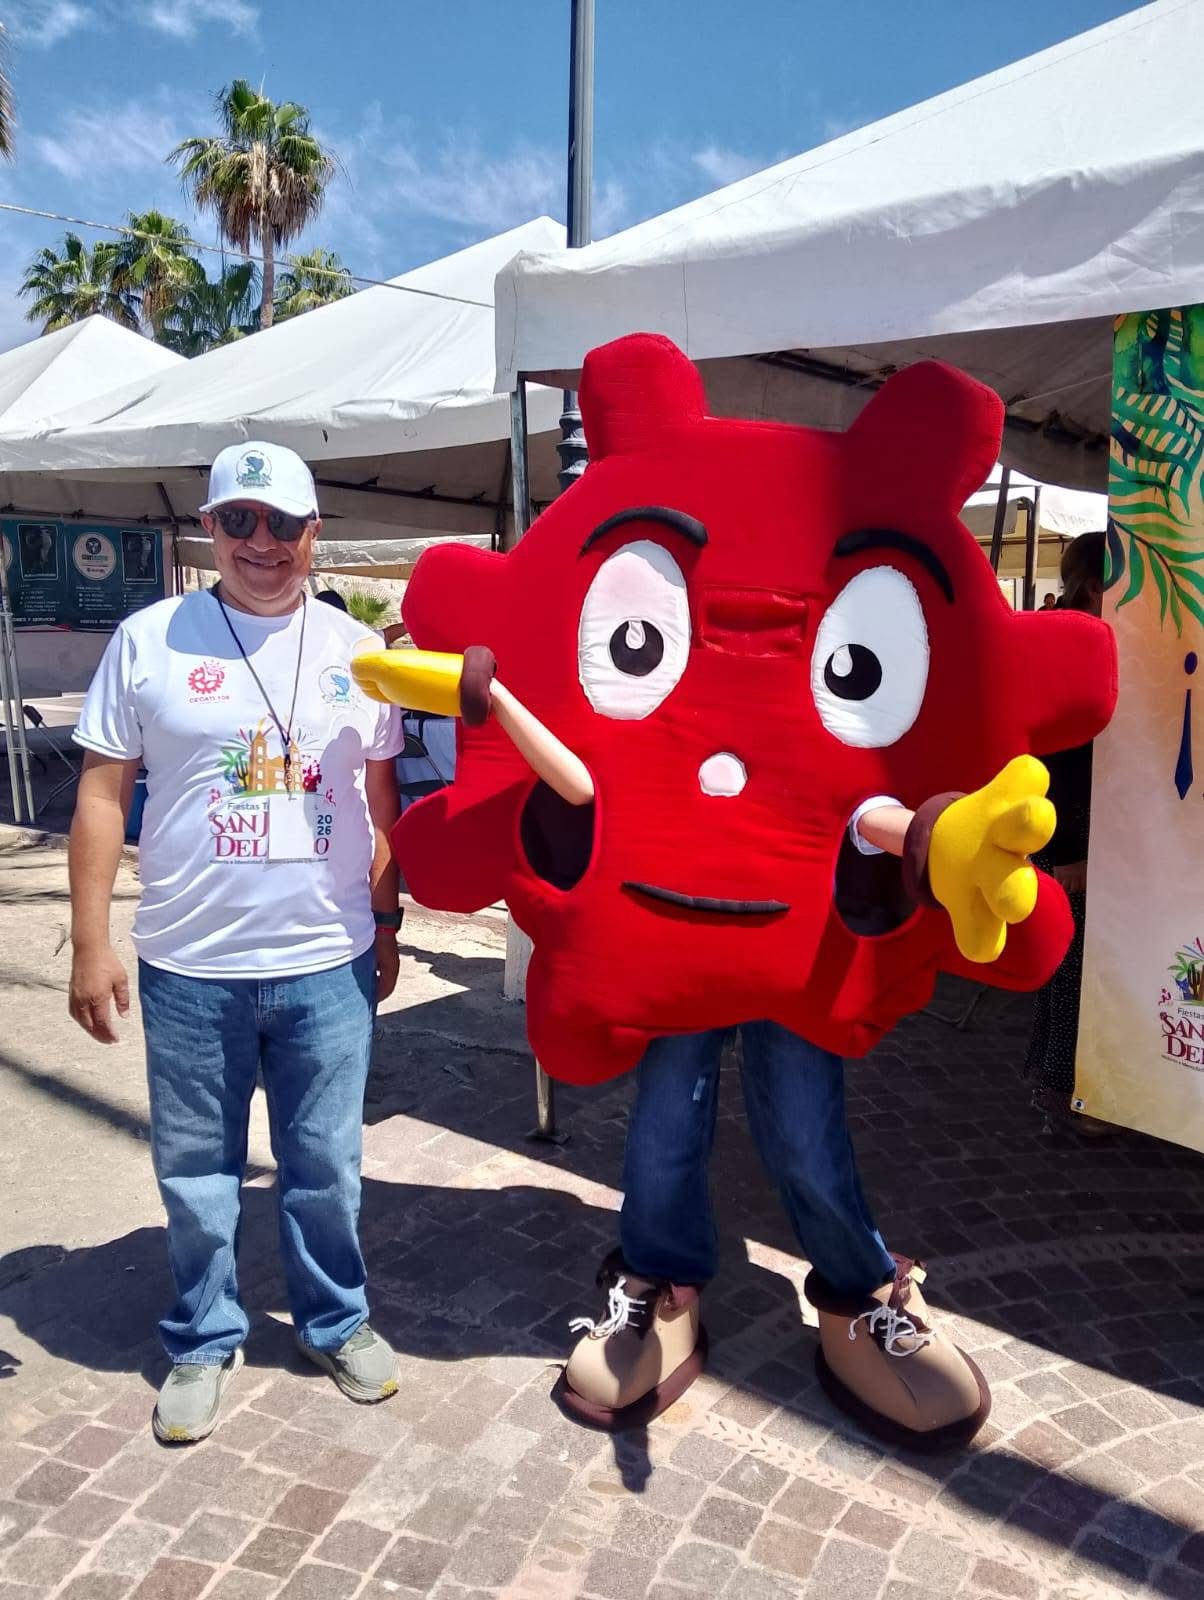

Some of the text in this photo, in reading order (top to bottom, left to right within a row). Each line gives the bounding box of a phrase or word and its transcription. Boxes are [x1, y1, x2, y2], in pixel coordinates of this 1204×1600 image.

[227, 802, 260, 811] Fiestas
[208, 811, 271, 838] SAN J
[317, 814, 333, 825] 20
[317, 825, 332, 835] 26
[209, 835, 330, 857] DEL O
